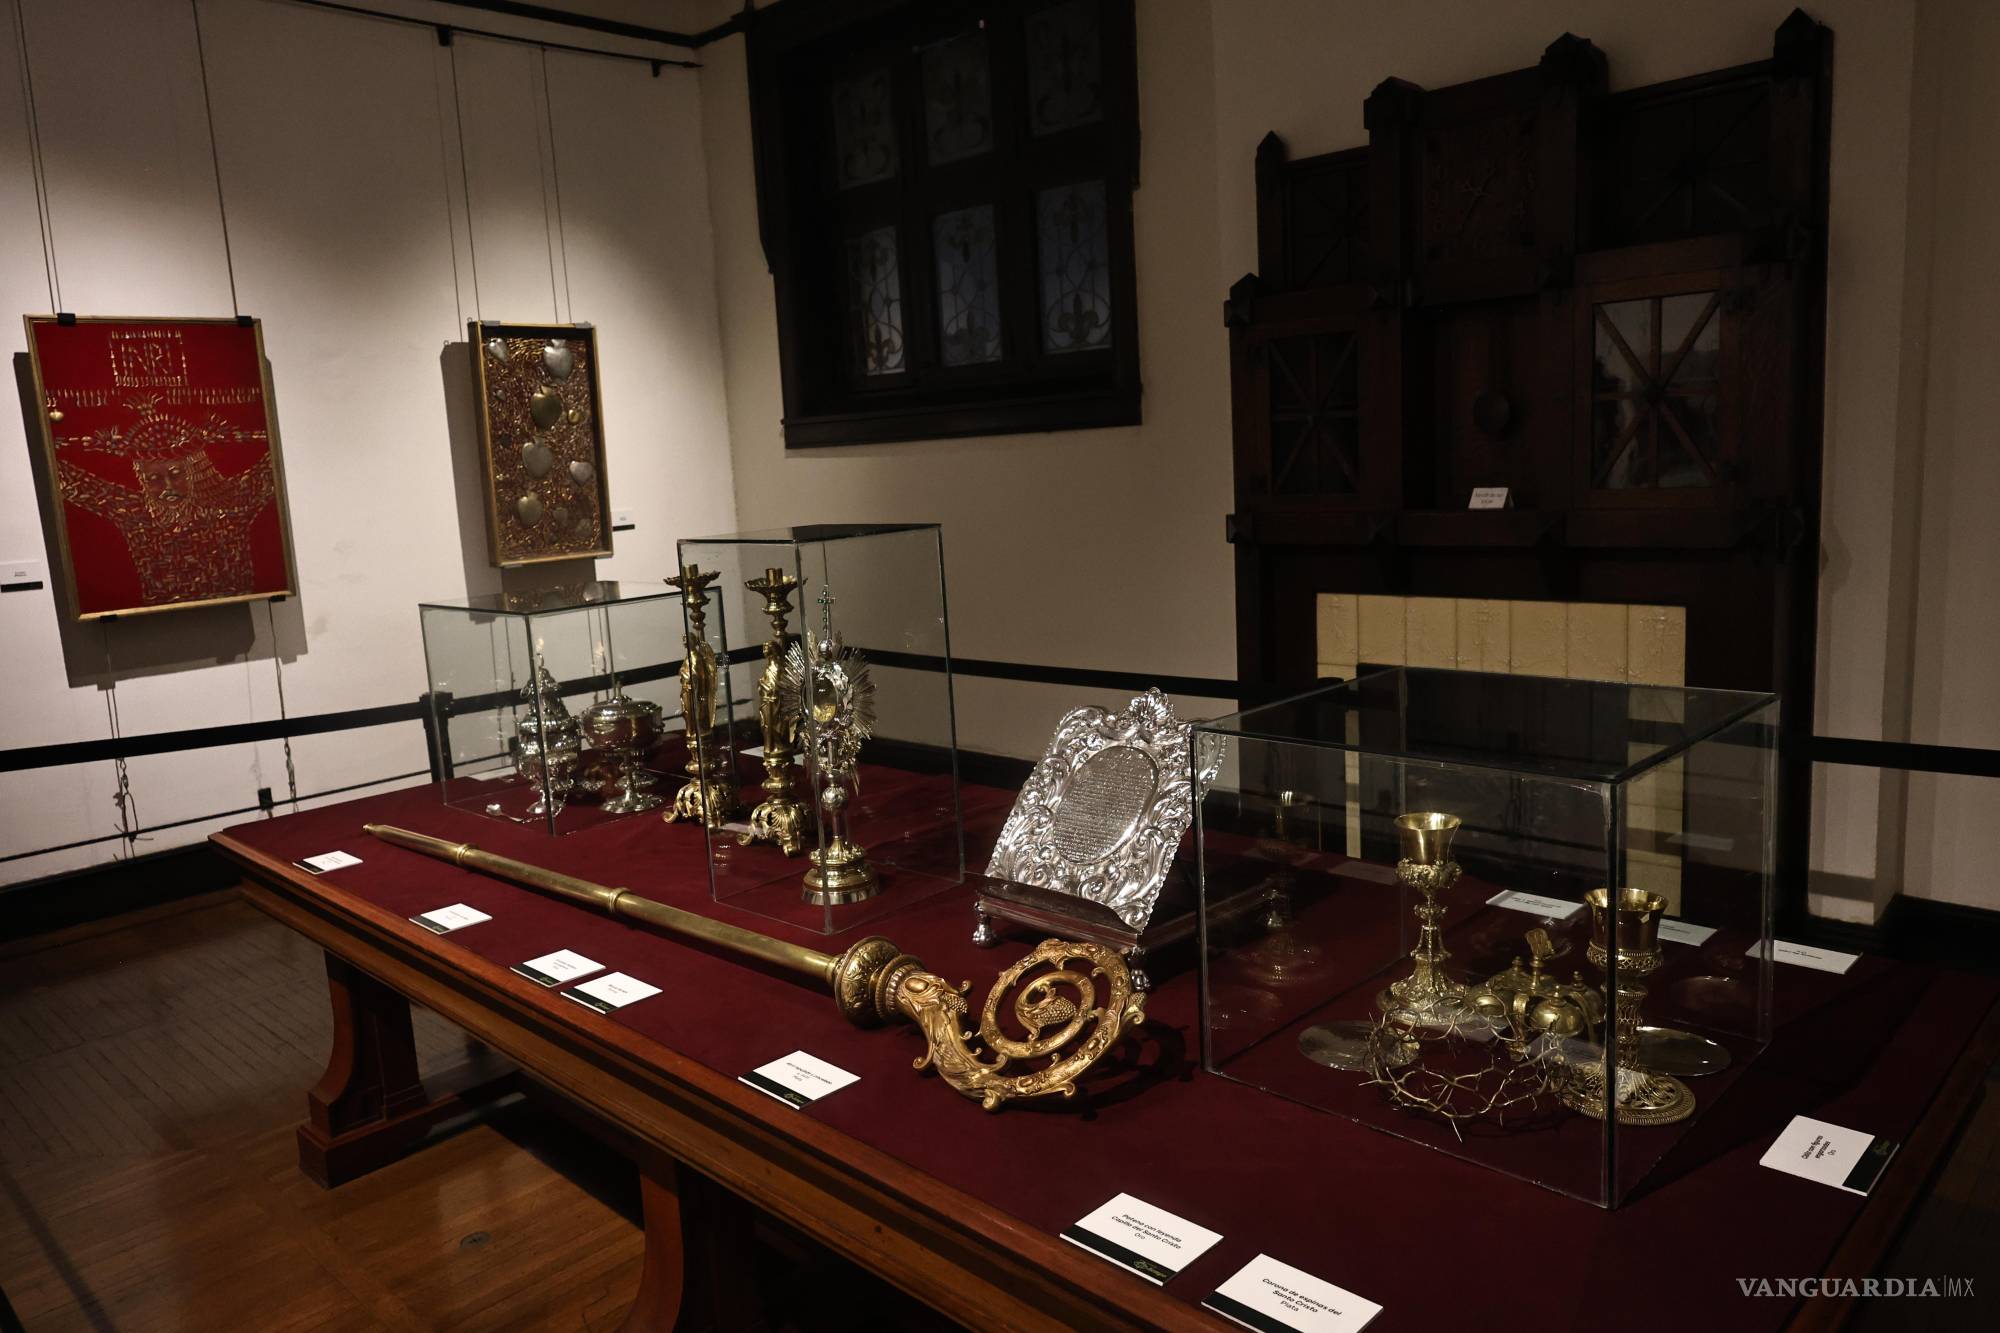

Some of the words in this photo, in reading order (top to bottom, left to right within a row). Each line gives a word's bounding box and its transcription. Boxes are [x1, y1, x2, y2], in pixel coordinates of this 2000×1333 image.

[121, 343, 173, 375] INRI
[1143, 1230, 1161, 1240] Santo
[1161, 1238, 1181, 1249] Cristo
[1262, 1278, 1289, 1292] Corona
[1299, 1295, 1328, 1310] espinas
[1328, 1308, 1342, 1316] del
[1272, 1290, 1295, 1302] Santo
[1295, 1300, 1318, 1313] Cristo
[1280, 1300, 1299, 1312] Plata
